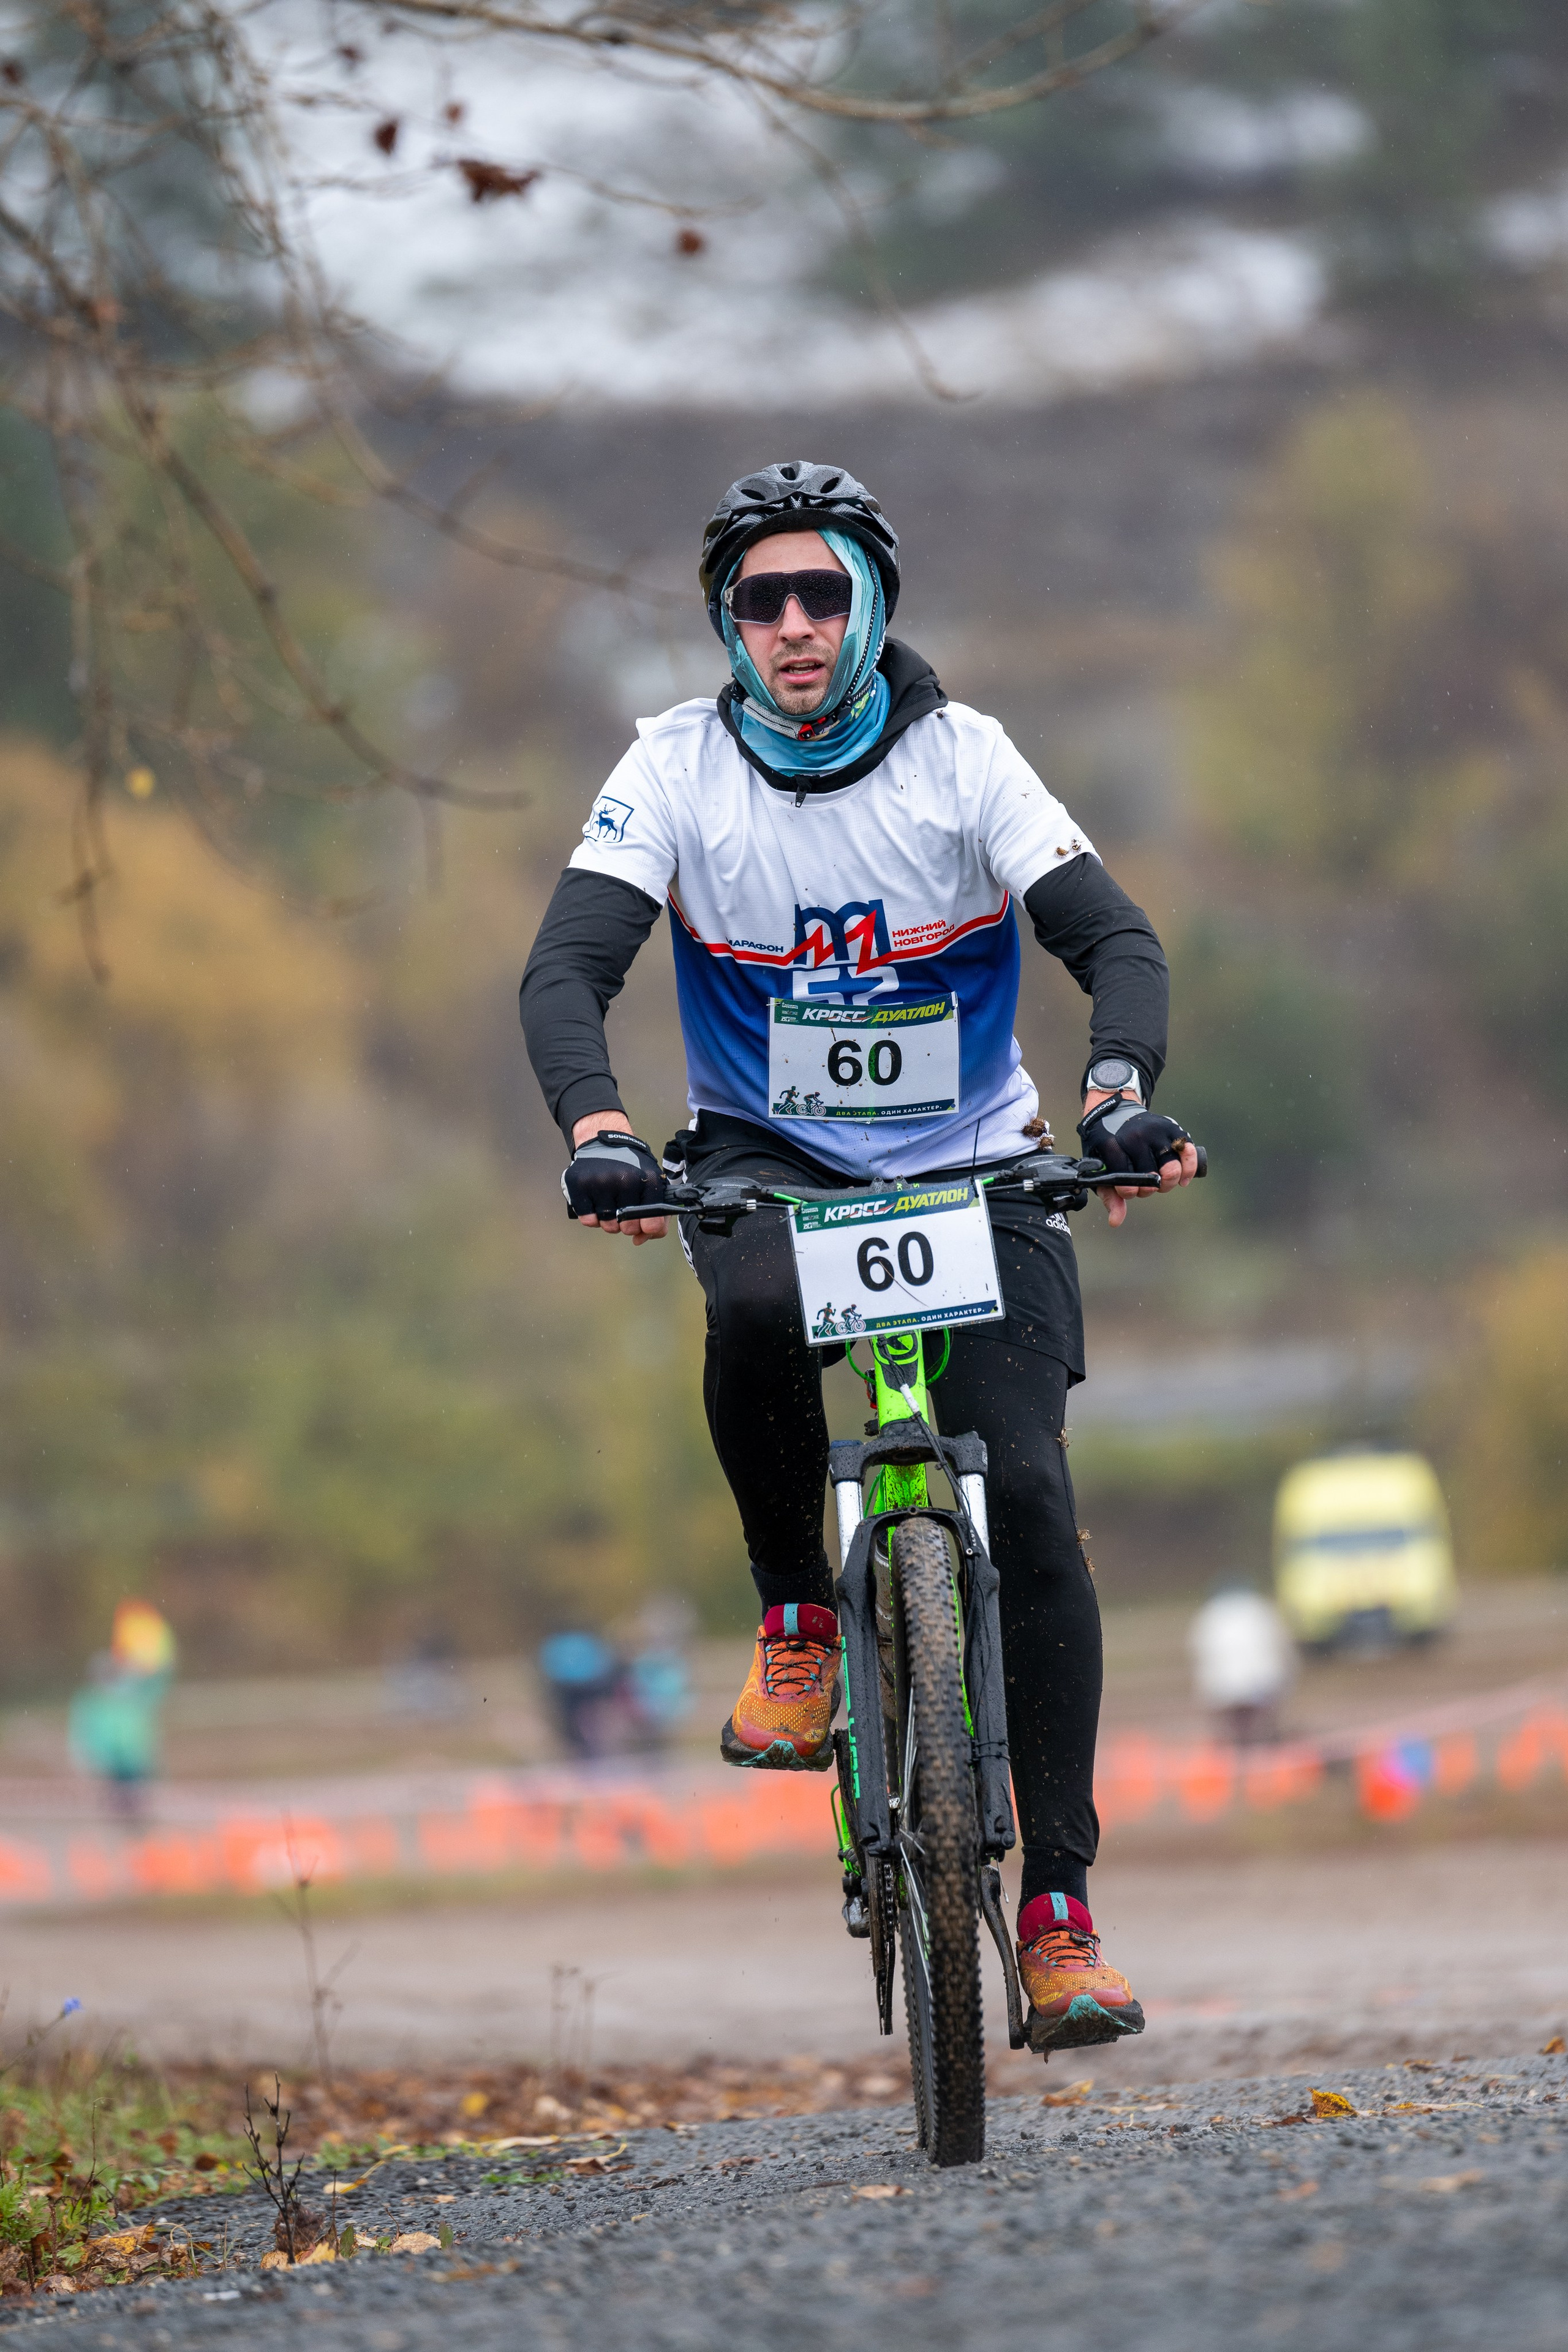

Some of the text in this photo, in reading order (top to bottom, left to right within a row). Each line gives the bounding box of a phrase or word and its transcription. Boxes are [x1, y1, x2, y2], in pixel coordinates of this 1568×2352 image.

[892, 919, 946, 938] НИЖНИЙ
[893, 924, 955, 948] НОВГОРОД
[802, 1001, 946, 1024] КРОСС ДУАТЛОН
[827, 1039, 902, 1087] 60
[903, 1105, 942, 1114] ХАРАКТЕР.
[1082, 1099, 1116, 1126] ROCKBROS
[824, 1187, 968, 1223] КРОСС ДУАТЛОН
[1046, 1216, 1072, 1237] adida
[856, 1231, 934, 1292] 60
[892, 1317, 920, 1326] ЭТАПА.
[944, 1308, 985, 1317] ХАРАКТЕР.
